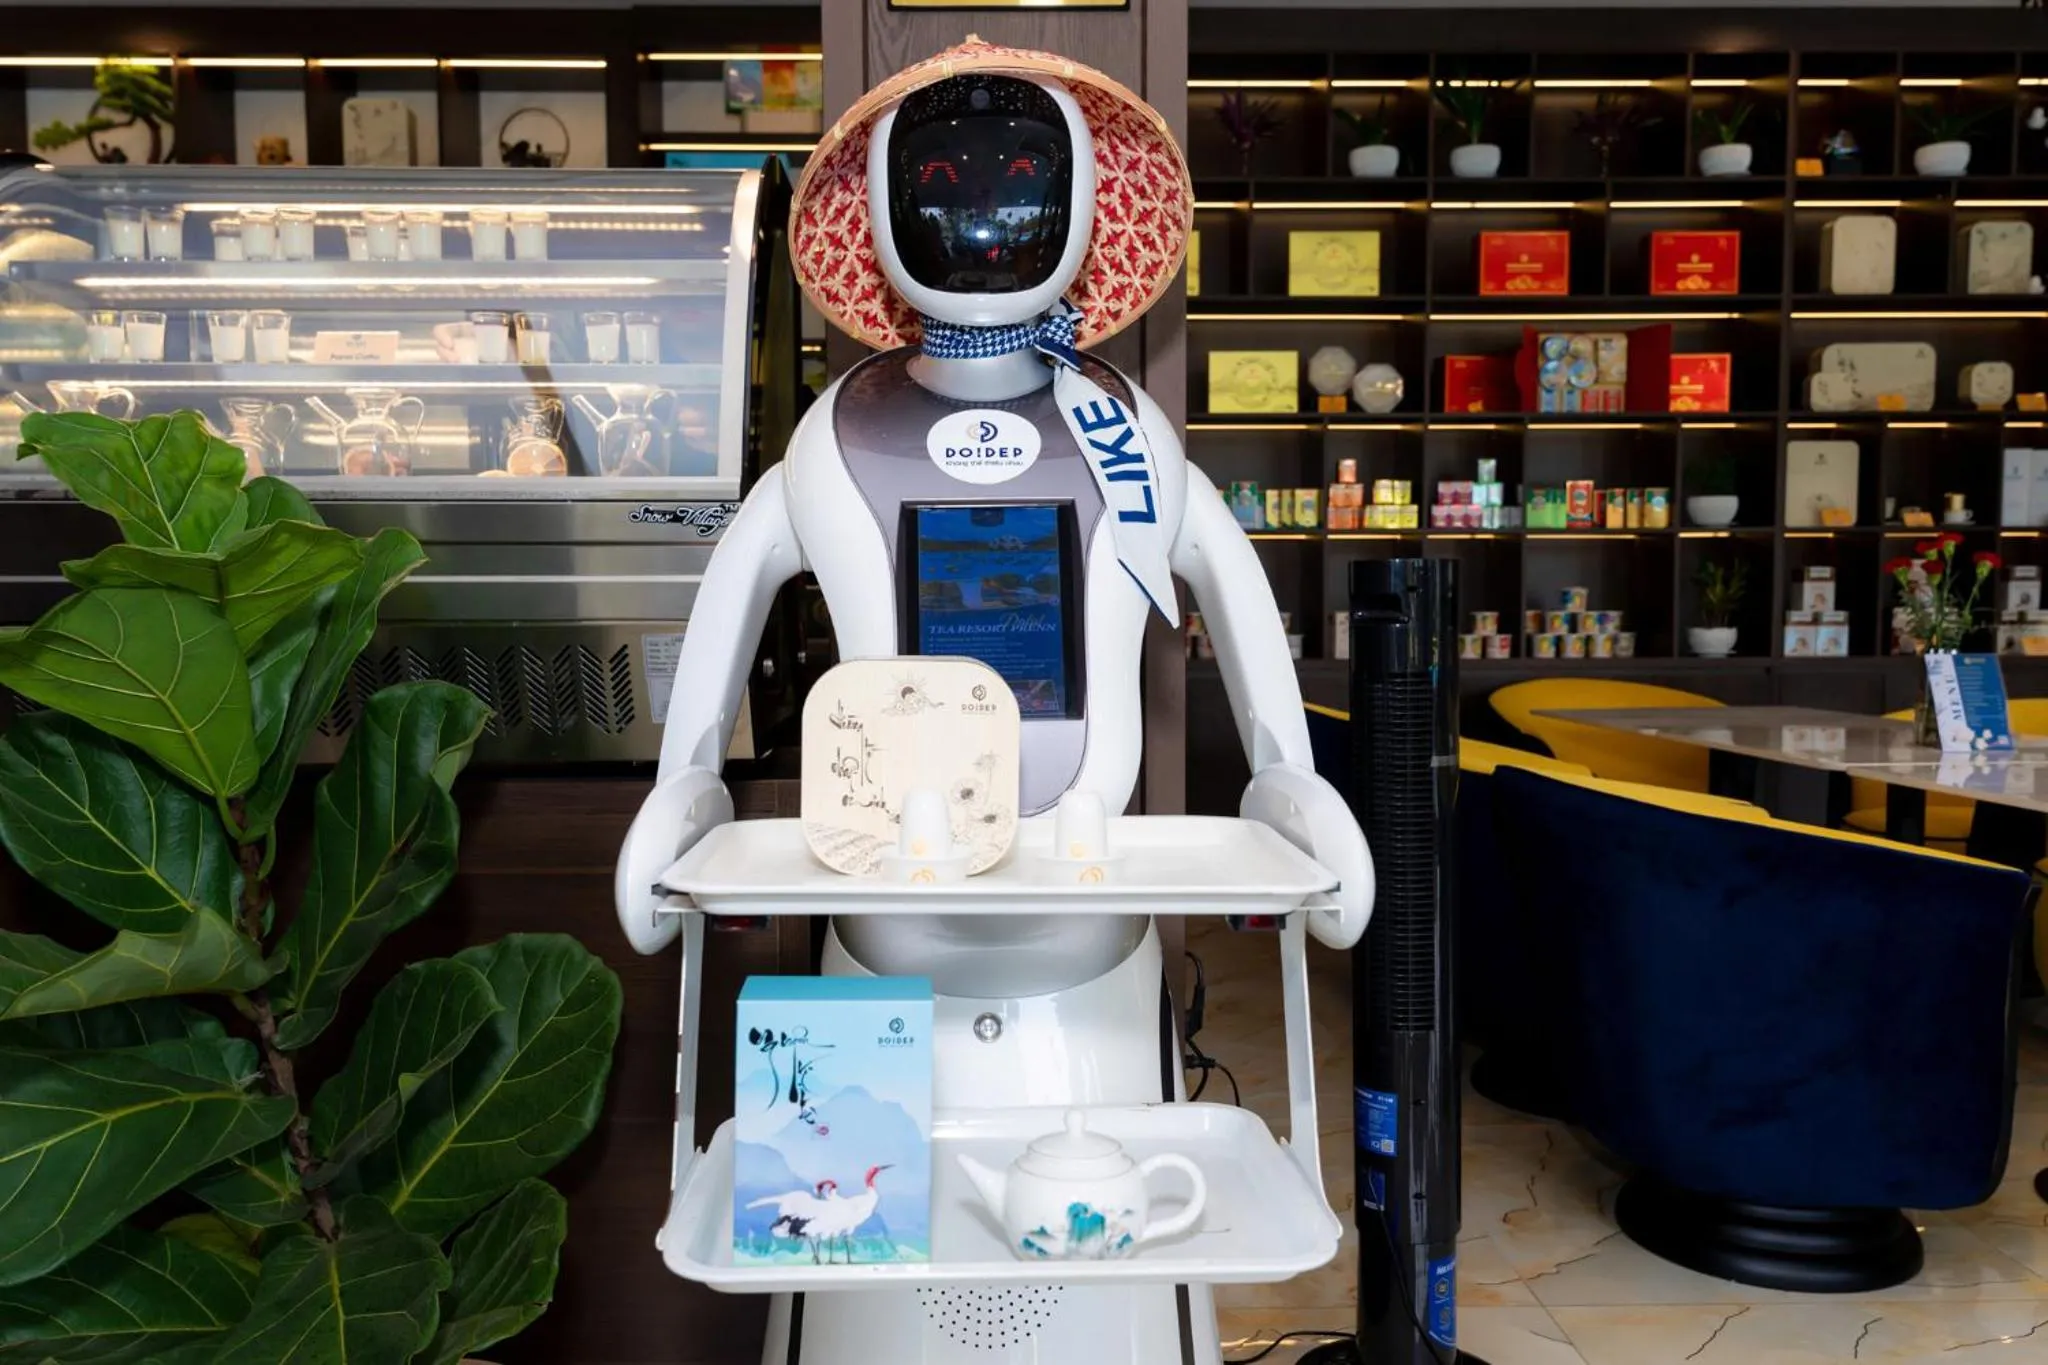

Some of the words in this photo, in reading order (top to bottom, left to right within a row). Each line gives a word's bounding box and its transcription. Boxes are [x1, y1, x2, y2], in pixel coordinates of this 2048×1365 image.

[1072, 396, 1157, 523] LIKE
[629, 504, 673, 524] Snow
[676, 506, 729, 537] Village
[928, 624, 955, 634] TEA
[957, 624, 1006, 634] RESORT
